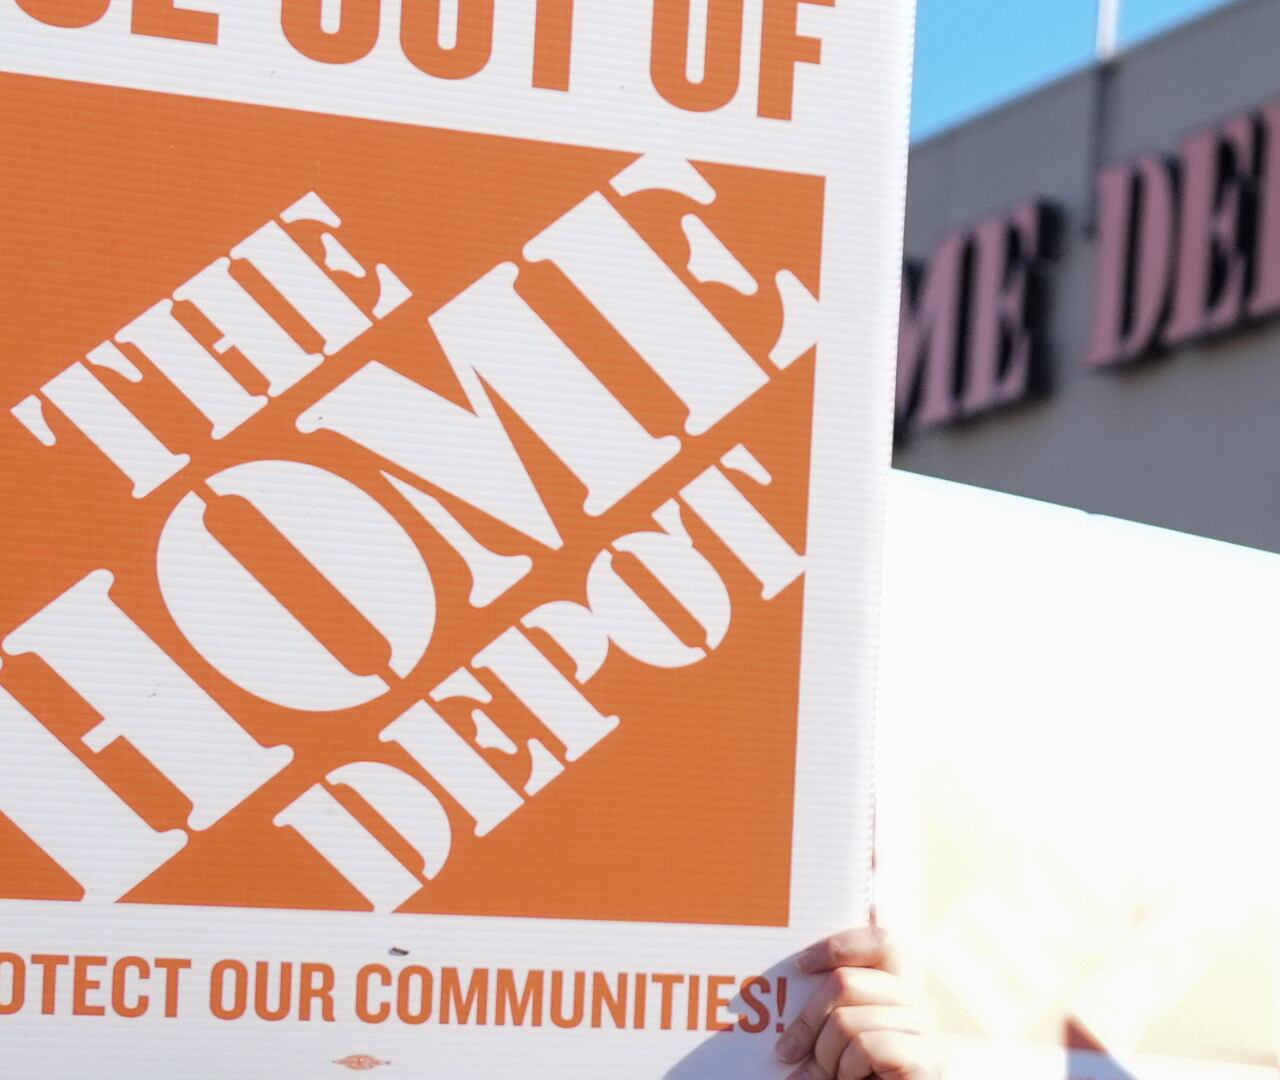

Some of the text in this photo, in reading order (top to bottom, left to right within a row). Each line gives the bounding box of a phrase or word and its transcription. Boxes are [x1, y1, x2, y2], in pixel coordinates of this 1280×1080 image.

[650, 0, 835, 120] OF
[11, 191, 413, 498] THE
[0, 153, 820, 902] HOME
[273, 443, 806, 912] DEPOT
[209, 959, 336, 1022] OUR
[355, 964, 789, 1034] COMMUNITIES!
